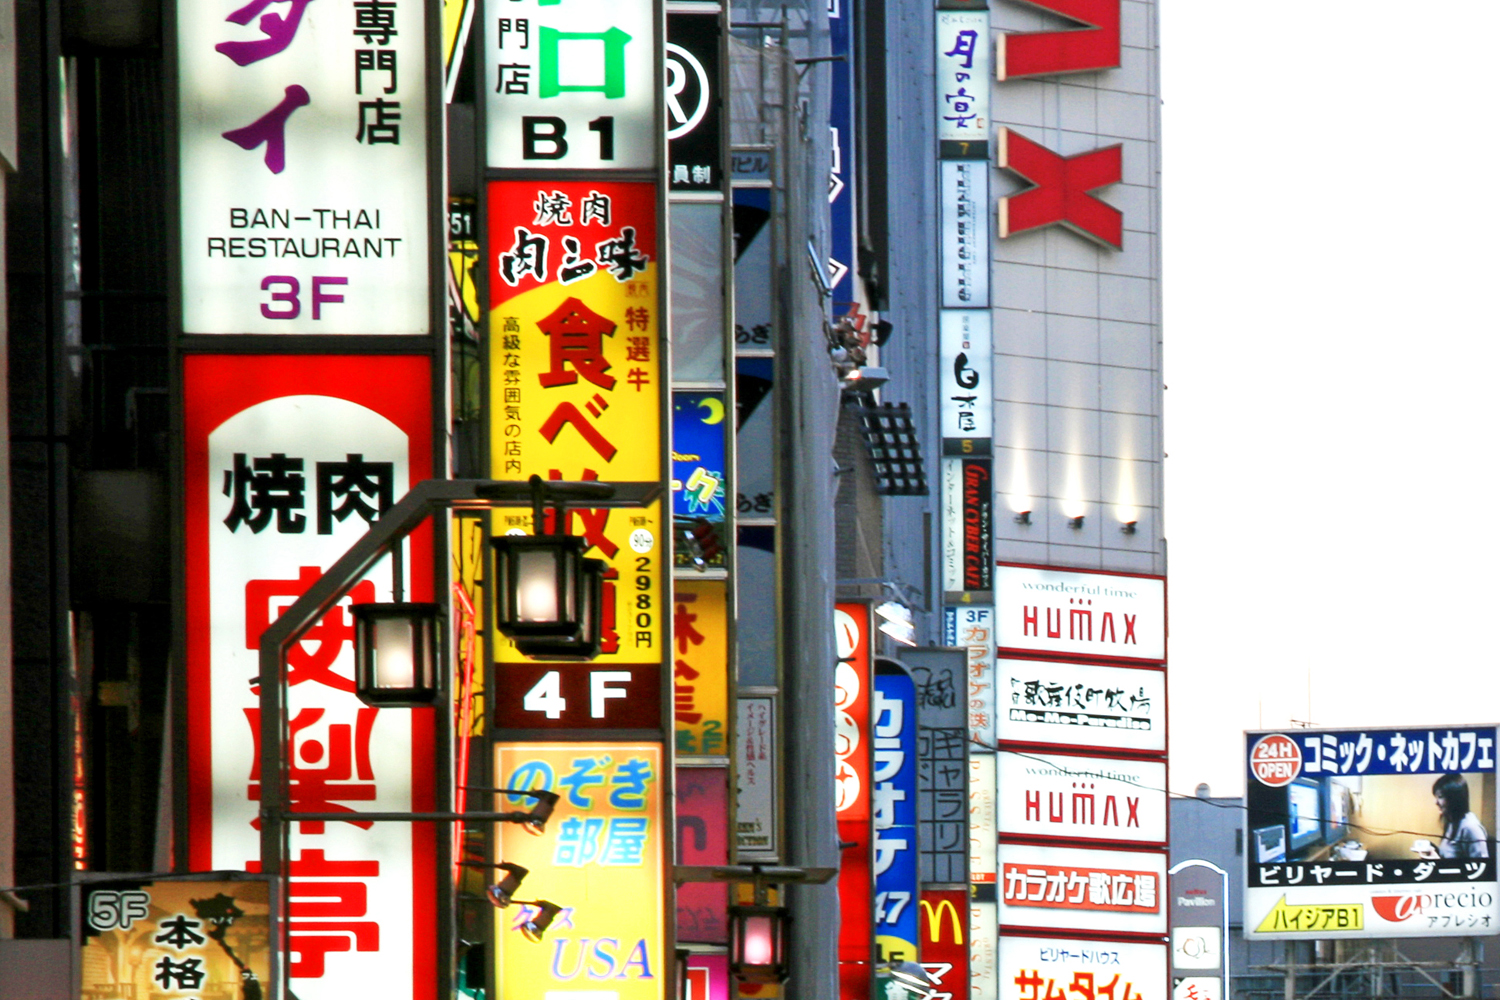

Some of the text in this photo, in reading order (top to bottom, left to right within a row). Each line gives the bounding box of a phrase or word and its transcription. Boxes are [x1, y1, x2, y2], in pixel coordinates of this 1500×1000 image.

[521, 115, 615, 161] B1
[229, 207, 382, 230] BAN-THAI
[533, 190, 612, 226] 焼肉
[206, 236, 403, 259] RESTAURANT
[259, 275, 349, 320] 3F
[625, 306, 651, 392] 特選牛
[222, 453, 395, 537] 焼肉
[635, 556, 652, 649] 2980円
[1022, 581, 1101, 598] wonderful
[522, 670, 632, 719] 4F
[1258, 742, 1293, 758] 24H
[1258, 763, 1293, 779] OPEN
[1303, 731, 1495, 774] コミック・ネットカフェ
[243, 566, 380, 979] 安楽亭
[508, 755, 655, 809] のぞき
[553, 817, 650, 868] 部屋
[1005, 867, 1156, 908] カラオケ歌広場
[1258, 861, 1488, 885] ビリヤード・ダーツ
[90, 892, 149, 930] 5F
[553, 937, 656, 981] USA
